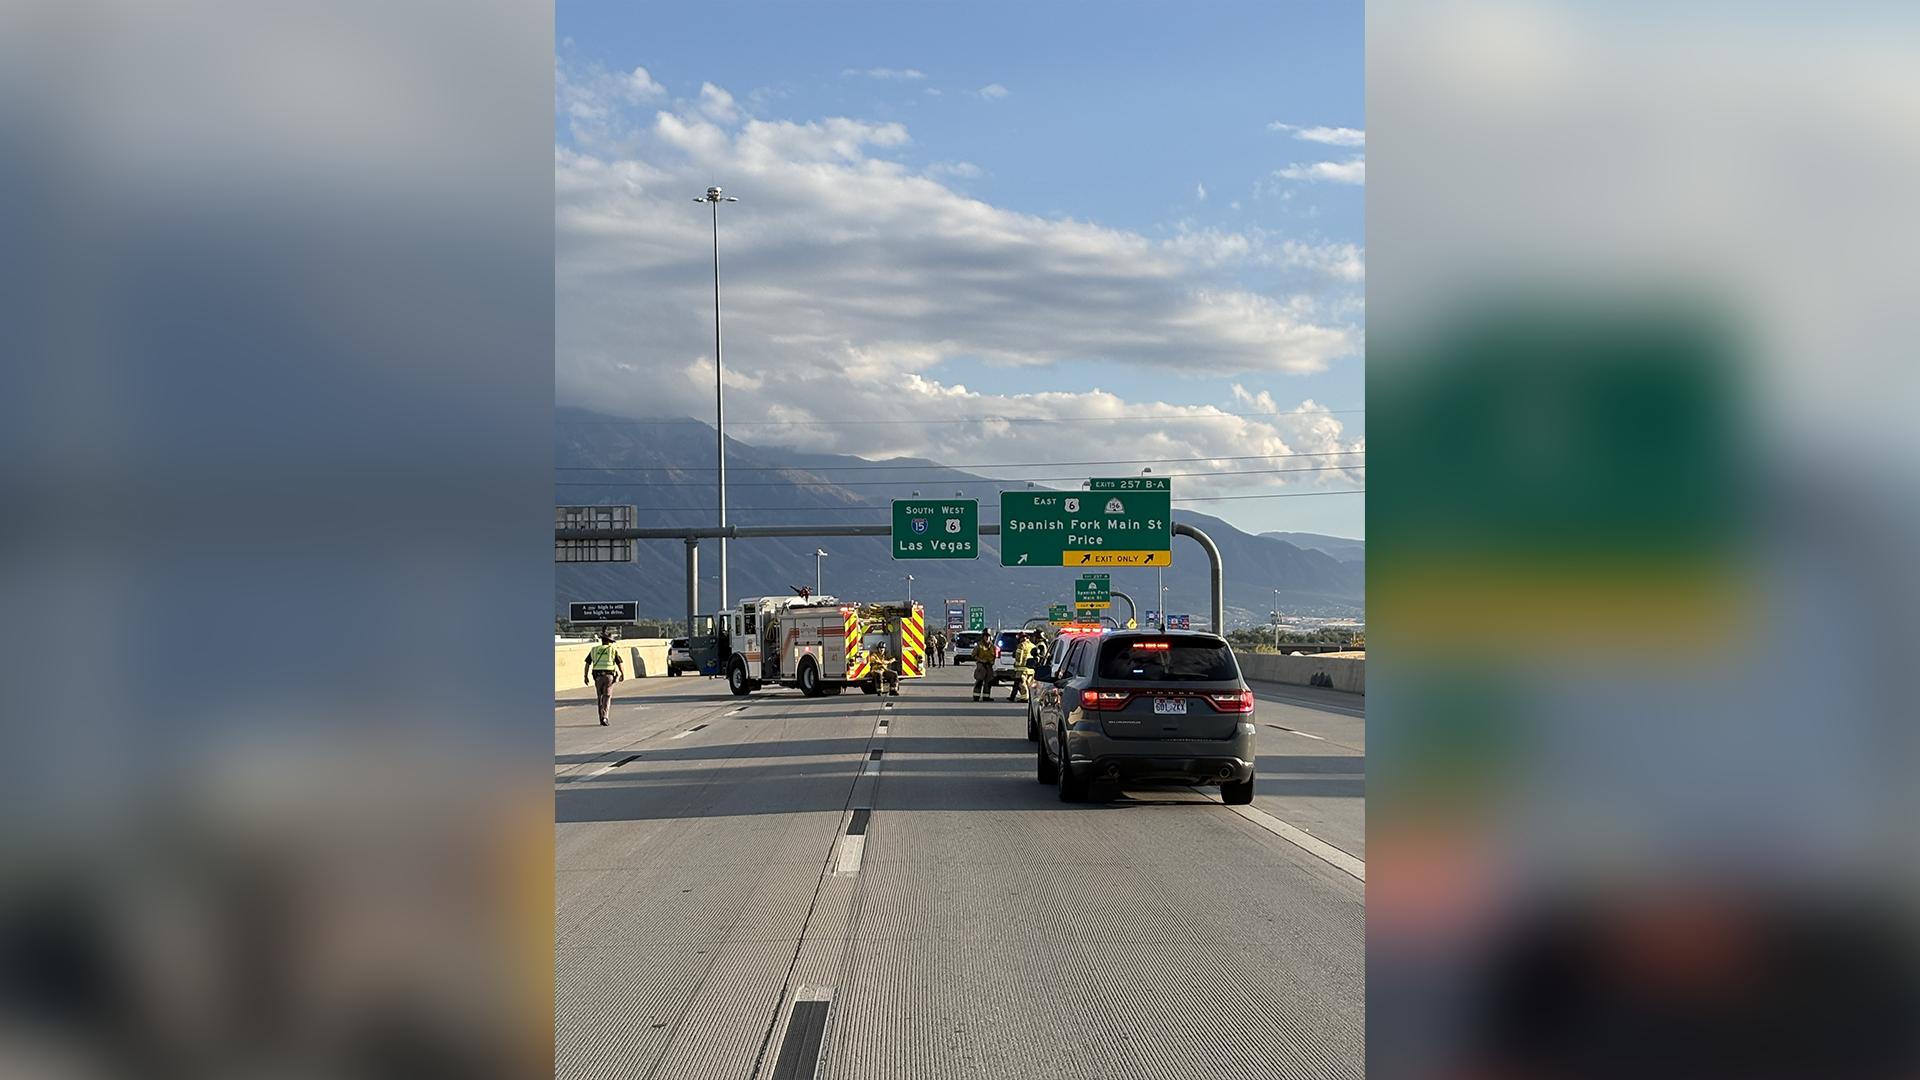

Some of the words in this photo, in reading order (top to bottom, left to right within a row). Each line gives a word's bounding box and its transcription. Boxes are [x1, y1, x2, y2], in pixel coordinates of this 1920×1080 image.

[1120, 480, 1141, 489] 257
[1145, 480, 1165, 489] B-A
[1033, 497, 1057, 505] EAST
[1068, 501, 1076, 511] 6
[905, 505, 934, 515] SOUTH
[941, 505, 965, 515] WEST
[914, 521, 925, 532] 15
[949, 521, 957, 531] 6
[1009, 519, 1064, 533] Spanish
[1070, 519, 1101, 530] Fork
[1107, 519, 1140, 530] Main
[1147, 519, 1163, 530] St
[1068, 534, 1104, 545] Price
[899, 540, 924, 551] Las
[930, 540, 972, 553] Vegas
[1095, 555, 1113, 563] EXIT
[1117, 555, 1139, 563] ONLY
